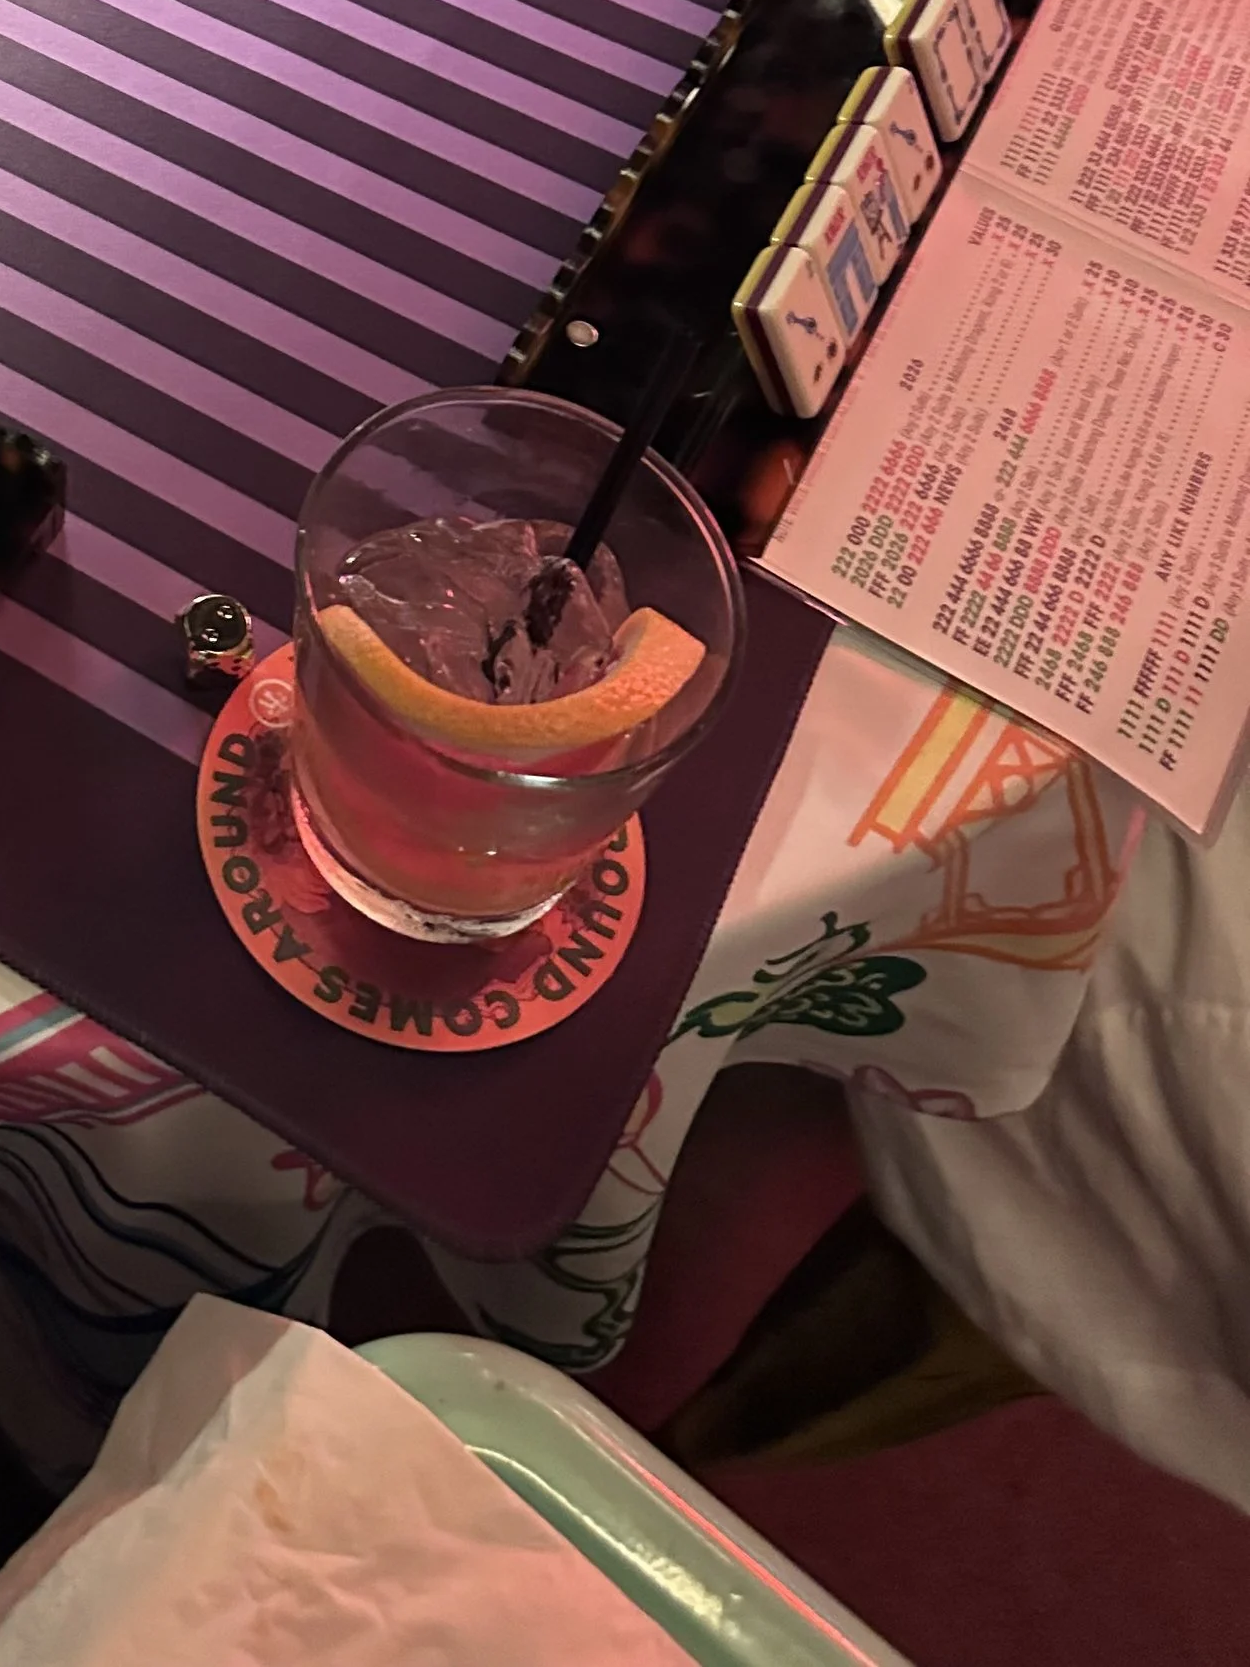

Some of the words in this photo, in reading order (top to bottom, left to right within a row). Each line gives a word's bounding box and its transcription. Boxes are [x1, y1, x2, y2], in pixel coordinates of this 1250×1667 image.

[966, 205, 997, 247] VALUES
[897, 356, 925, 391] 2026
[991, 406, 1019, 442] 2468
[1174, 449, 1216, 517] NUMBERS
[845, 513, 872, 547] 000
[894, 562, 918, 588] 00
[931, 462, 964, 506] NEWS
[971, 500, 1001, 539] 8888
[1165, 516, 1190, 549] LIKE
[955, 535, 986, 576] 6666
[1153, 549, 1178, 583] ANY
[943, 572, 969, 605] 444
[930, 601, 957, 635] 222
[1081, 656, 1111, 693] 246
[1074, 692, 1096, 715] FF
[210, 734, 311, 963] AROUND
[313, 966, 520, 1036] COMES
